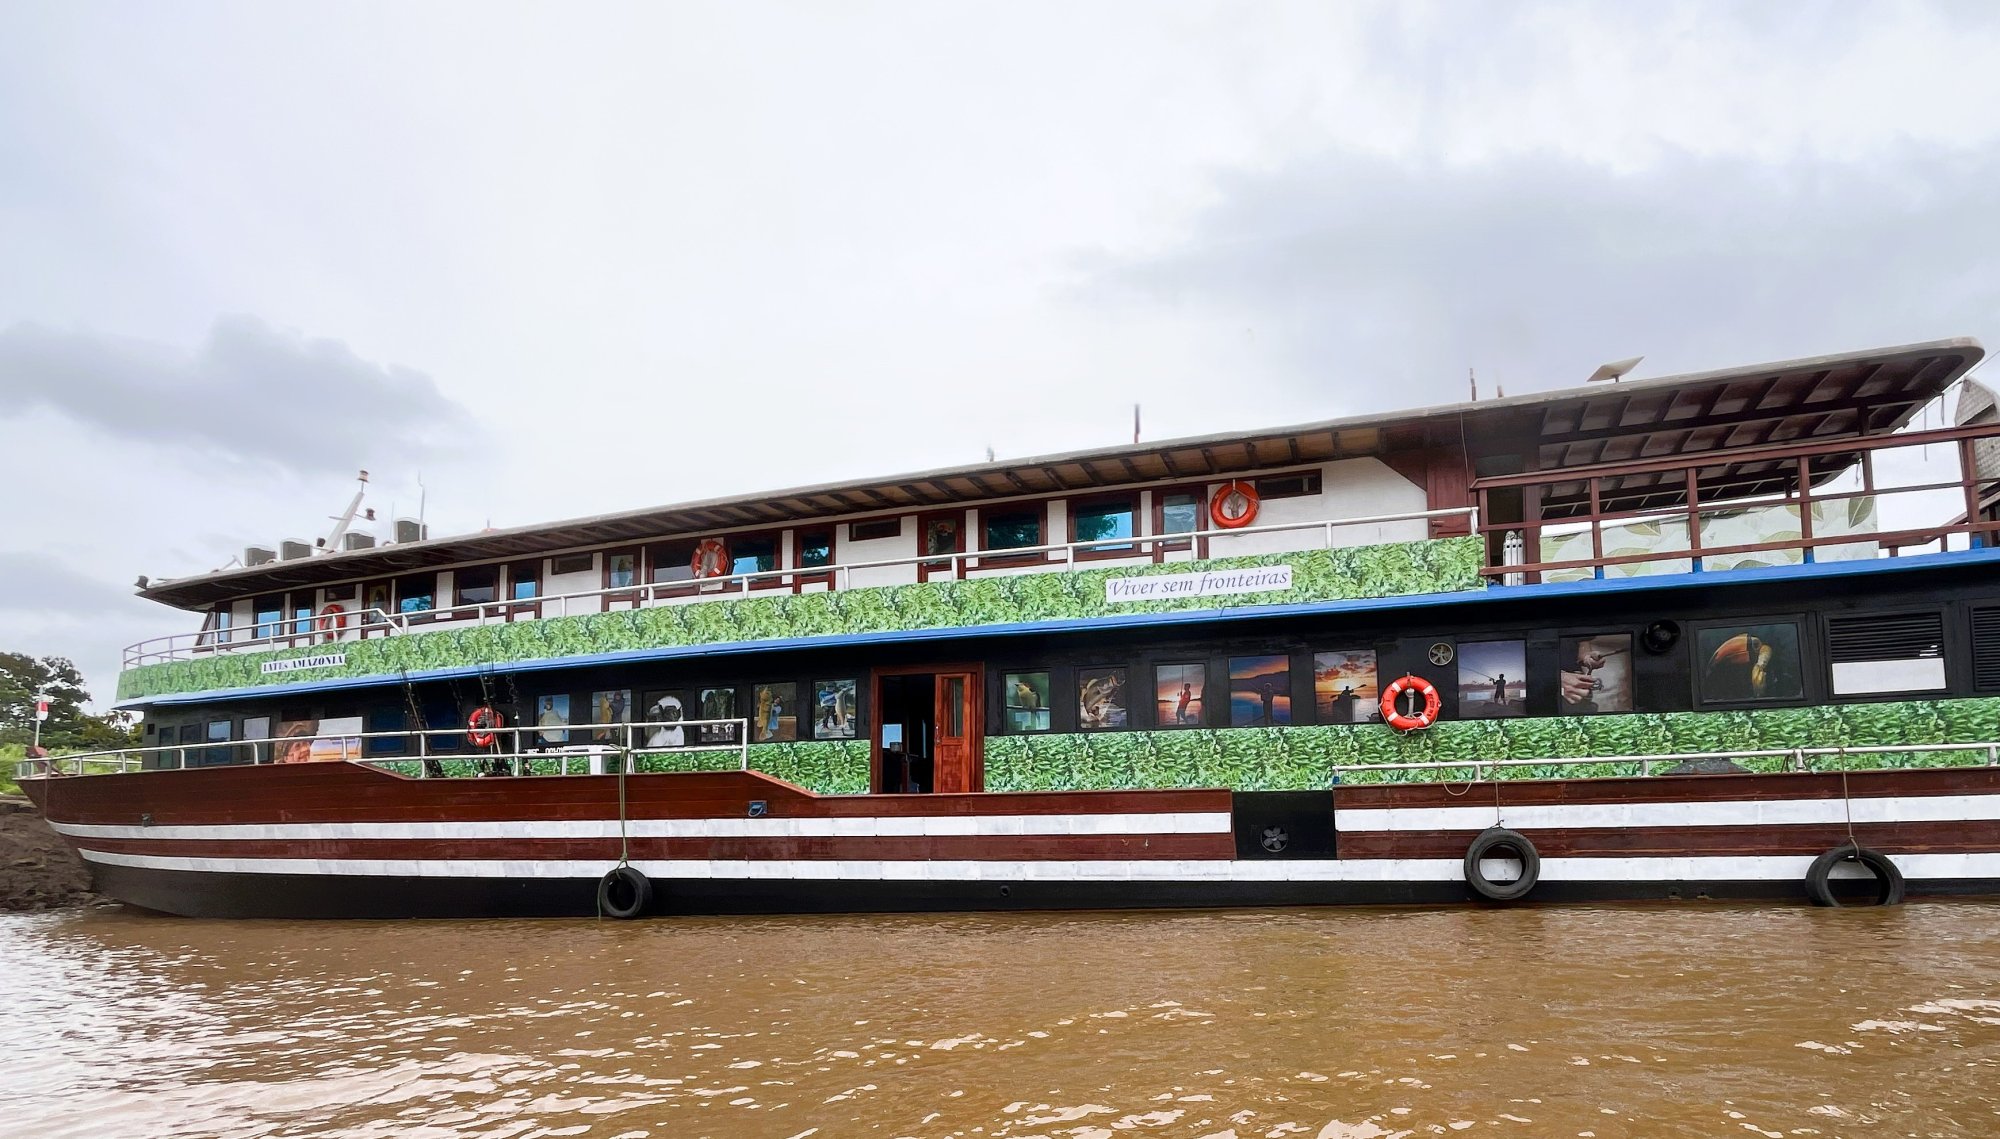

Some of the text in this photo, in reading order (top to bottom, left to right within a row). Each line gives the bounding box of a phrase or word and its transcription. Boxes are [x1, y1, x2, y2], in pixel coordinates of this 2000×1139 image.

[1108, 569, 1289, 596] Viver sem fronteiras
